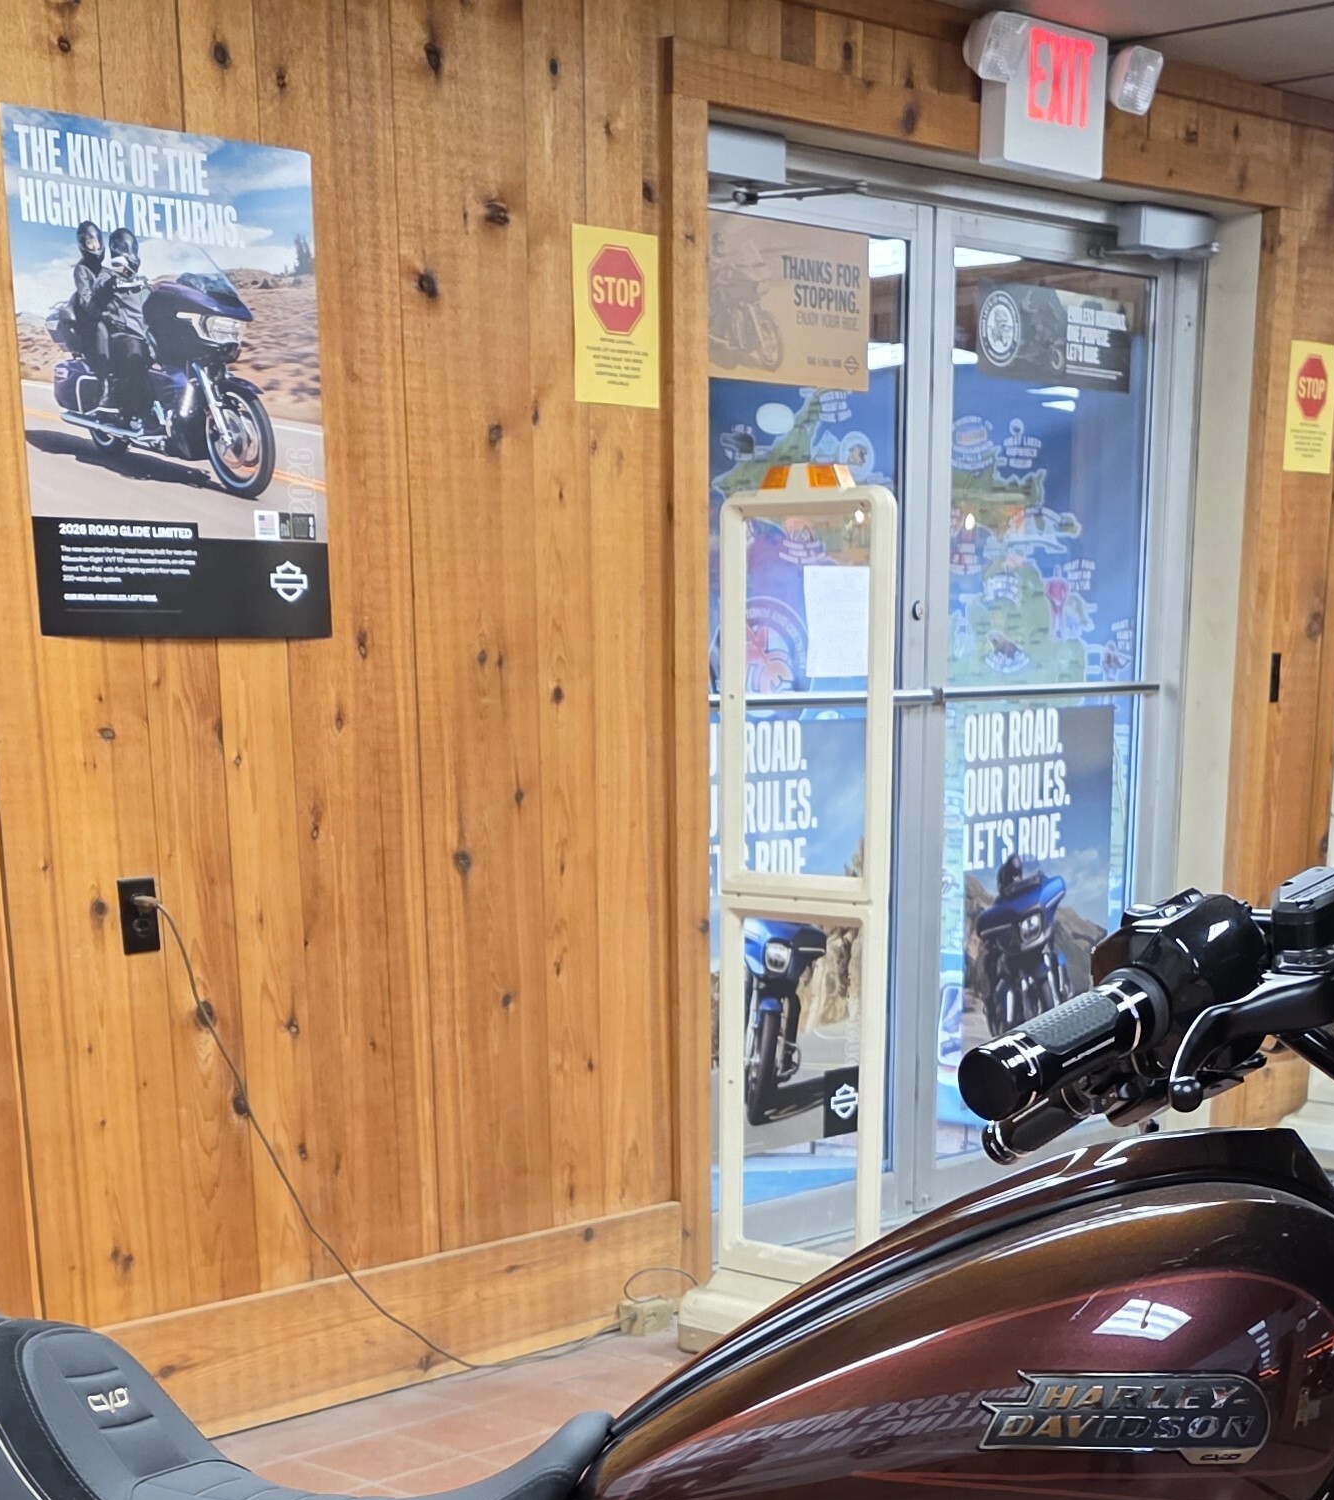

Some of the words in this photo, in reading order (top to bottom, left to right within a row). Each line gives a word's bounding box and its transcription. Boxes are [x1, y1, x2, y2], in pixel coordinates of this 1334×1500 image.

[1027, 27, 1095, 129] EXIT
[13, 124, 64, 176] THE
[66, 132, 126, 186] KING
[130, 143, 160, 190] OF
[163, 148, 210, 197] THE
[18, 176, 127, 234] HIGHWAY
[132, 193, 246, 249] RETURNS.
[781, 255, 833, 285] THANKS
[836, 263, 861, 289] FOR
[592, 274, 641, 308] STOP
[794, 283, 860, 314] STOPPING.
[1298, 377, 1325, 400] STOP
[88, 524, 118, 536] ROAD
[120, 526, 150, 537] GLIDE
[152, 527, 193, 539] LIMITED
[965, 712, 1004, 763] OUR
[1008, 708, 1063, 758] ROAD.
[964, 766, 1004, 817] OUR
[1007, 760, 1071, 812] RULES.
[963, 818, 1014, 872] LET'S
[1017, 813, 1066, 862] RIDE.
[1038, 1384, 1249, 1409] HARLEY-
[997, 1414, 1256, 1439] DAVIDSON
